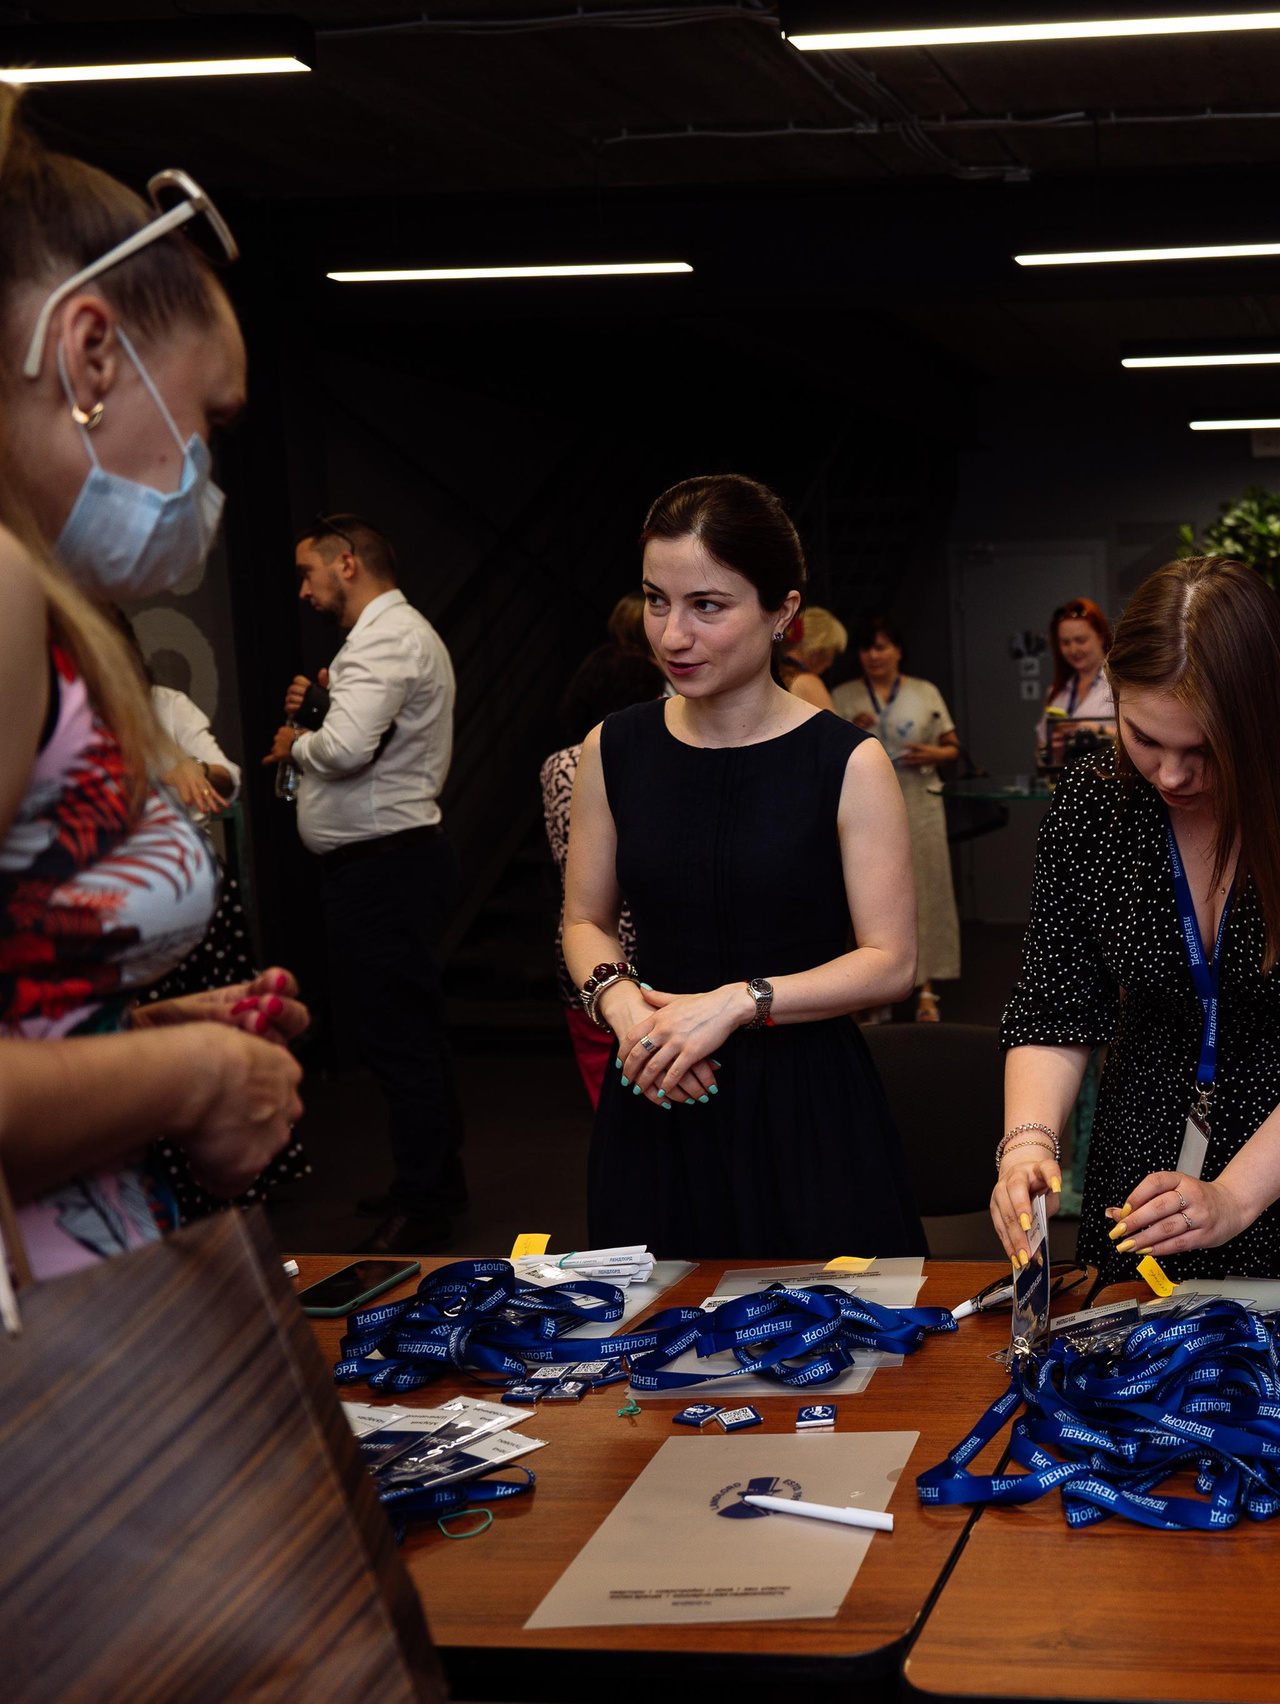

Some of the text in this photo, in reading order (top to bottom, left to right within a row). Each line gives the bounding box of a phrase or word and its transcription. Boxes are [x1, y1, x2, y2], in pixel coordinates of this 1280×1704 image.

[1183, 916, 1199, 966] ЛЕНДЛОРД
[736, 1320, 793, 1341] ЛЕНДЛОРД
[397, 1343, 448, 1357] ЛЕНДЛОРД
[601, 1336, 658, 1354] ЛЕНДЛОРД
[665, 1329, 703, 1357] ЛЕНДЛОРД
[1161, 1413, 1215, 1438] ЛЕНДЛОРД
